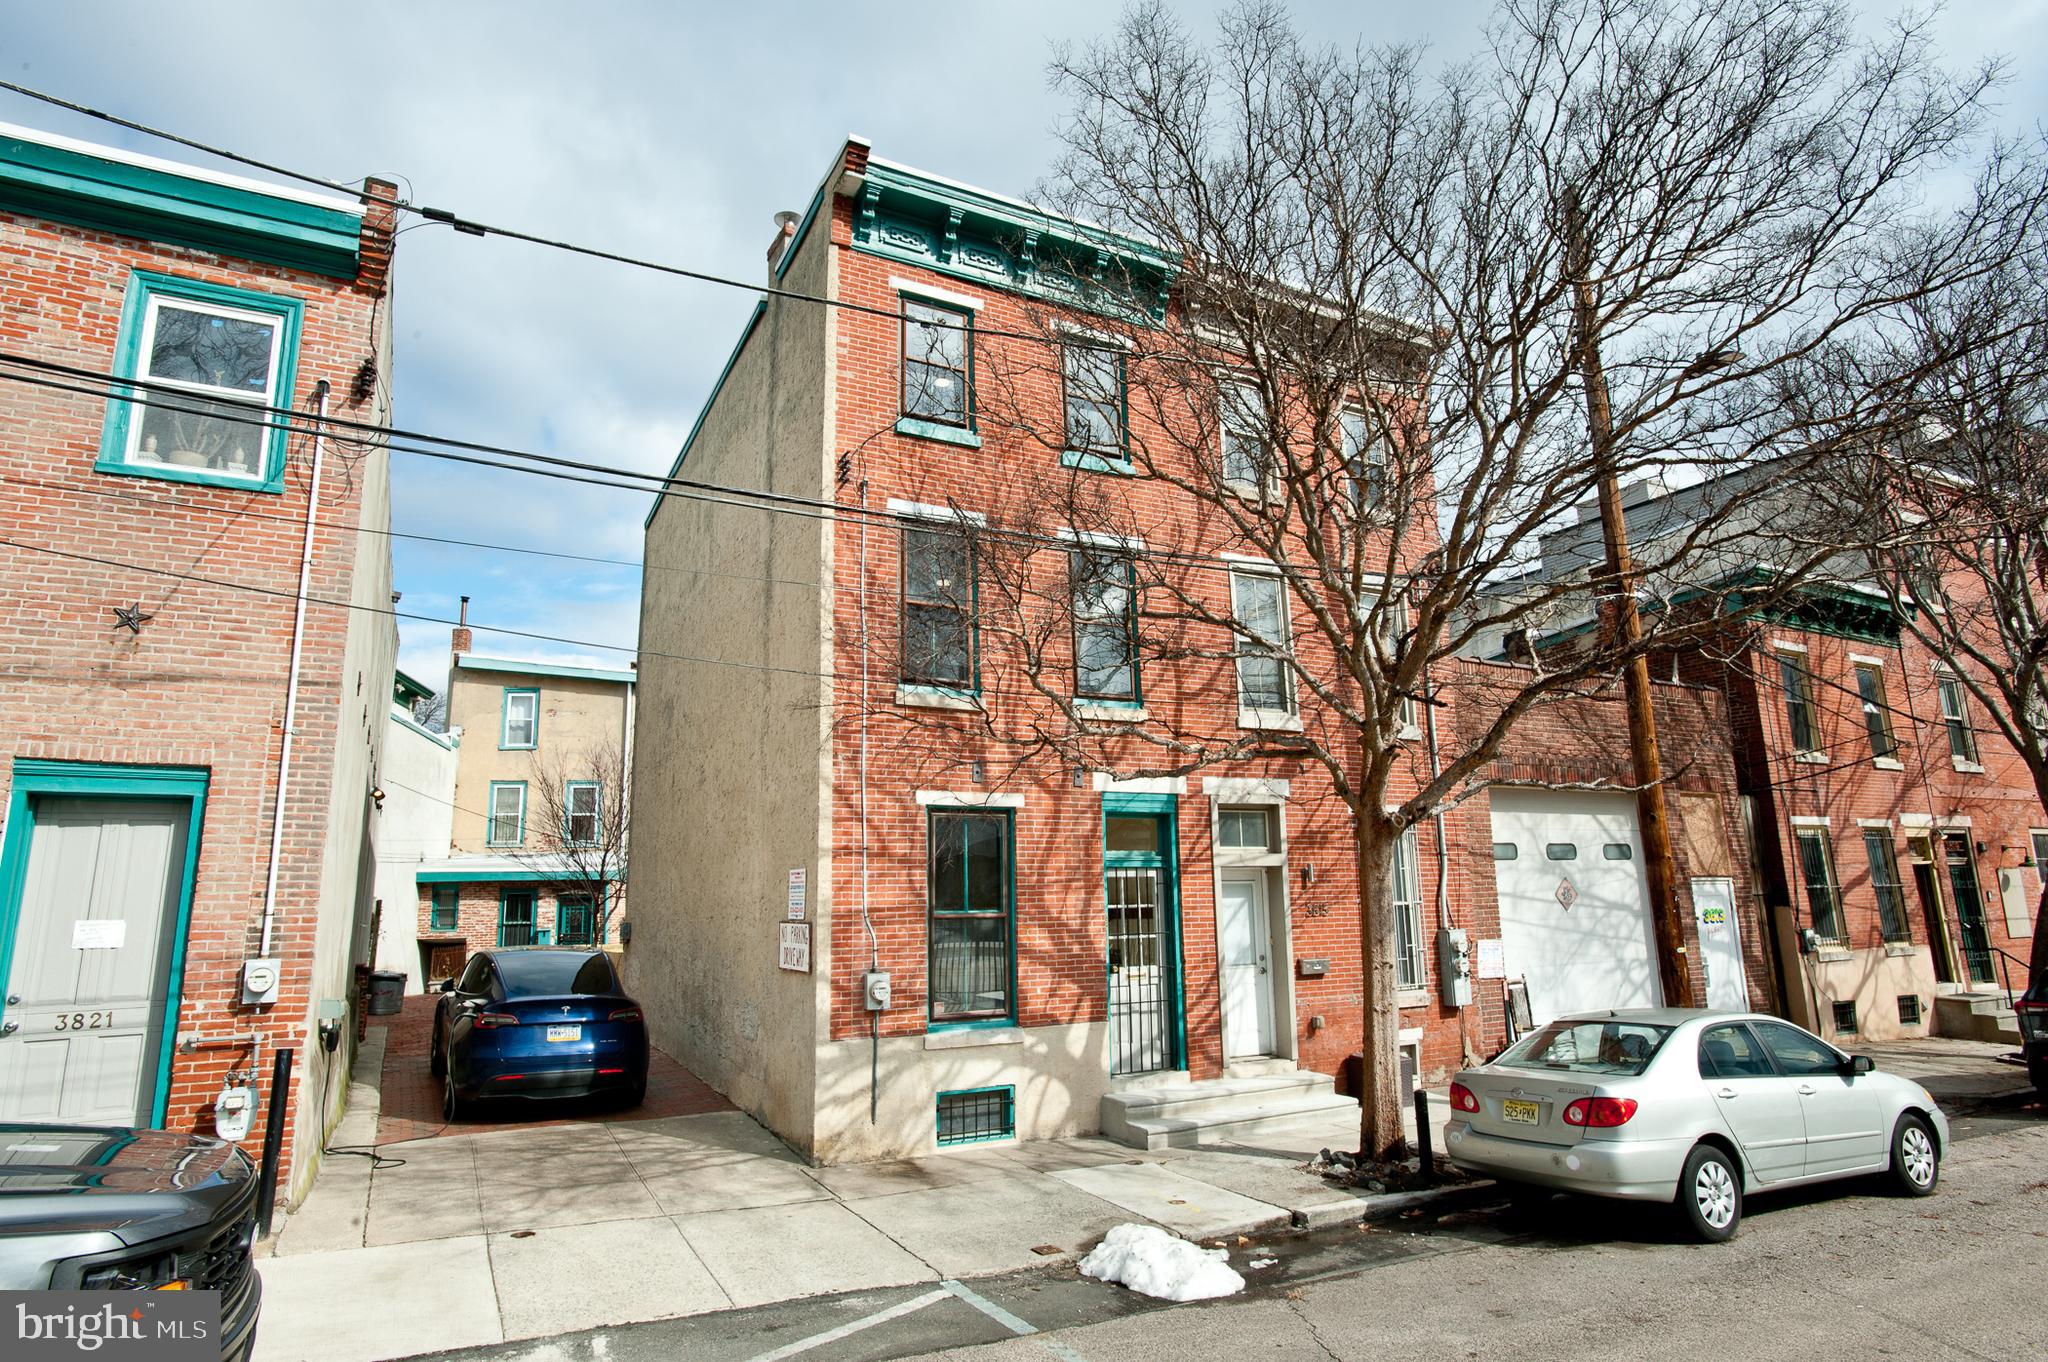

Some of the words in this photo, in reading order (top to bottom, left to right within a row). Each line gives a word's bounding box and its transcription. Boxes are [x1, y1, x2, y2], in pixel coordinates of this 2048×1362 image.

[781, 925, 788, 943] NO
[791, 925, 808, 945] PARKING
[54, 1011, 113, 1031] 3821
